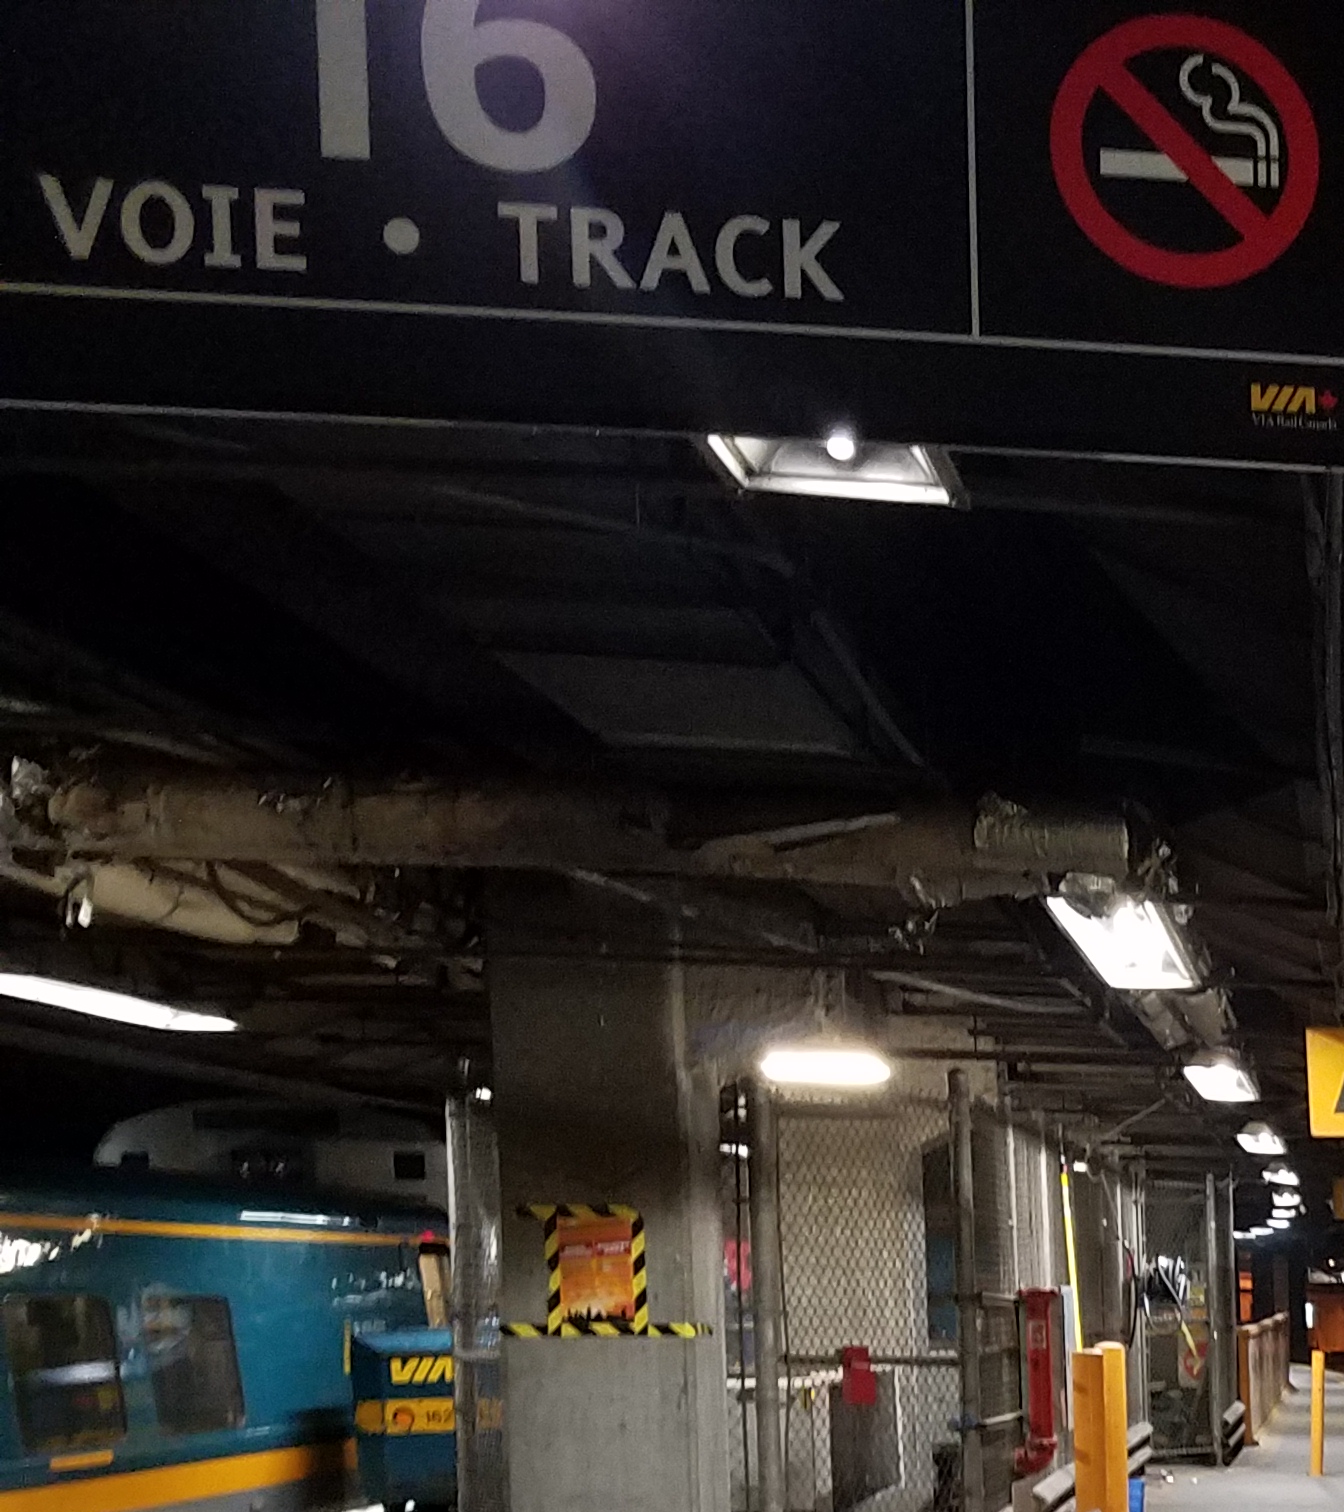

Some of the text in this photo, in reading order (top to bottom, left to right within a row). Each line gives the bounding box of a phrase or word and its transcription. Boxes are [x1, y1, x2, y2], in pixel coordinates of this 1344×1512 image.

[315, 0, 598, 174] 16
[38, 173, 846, 301] VOIE TRACK
[1250, 382, 1316, 415] VIA
[390, 1356, 454, 1385] VIA
